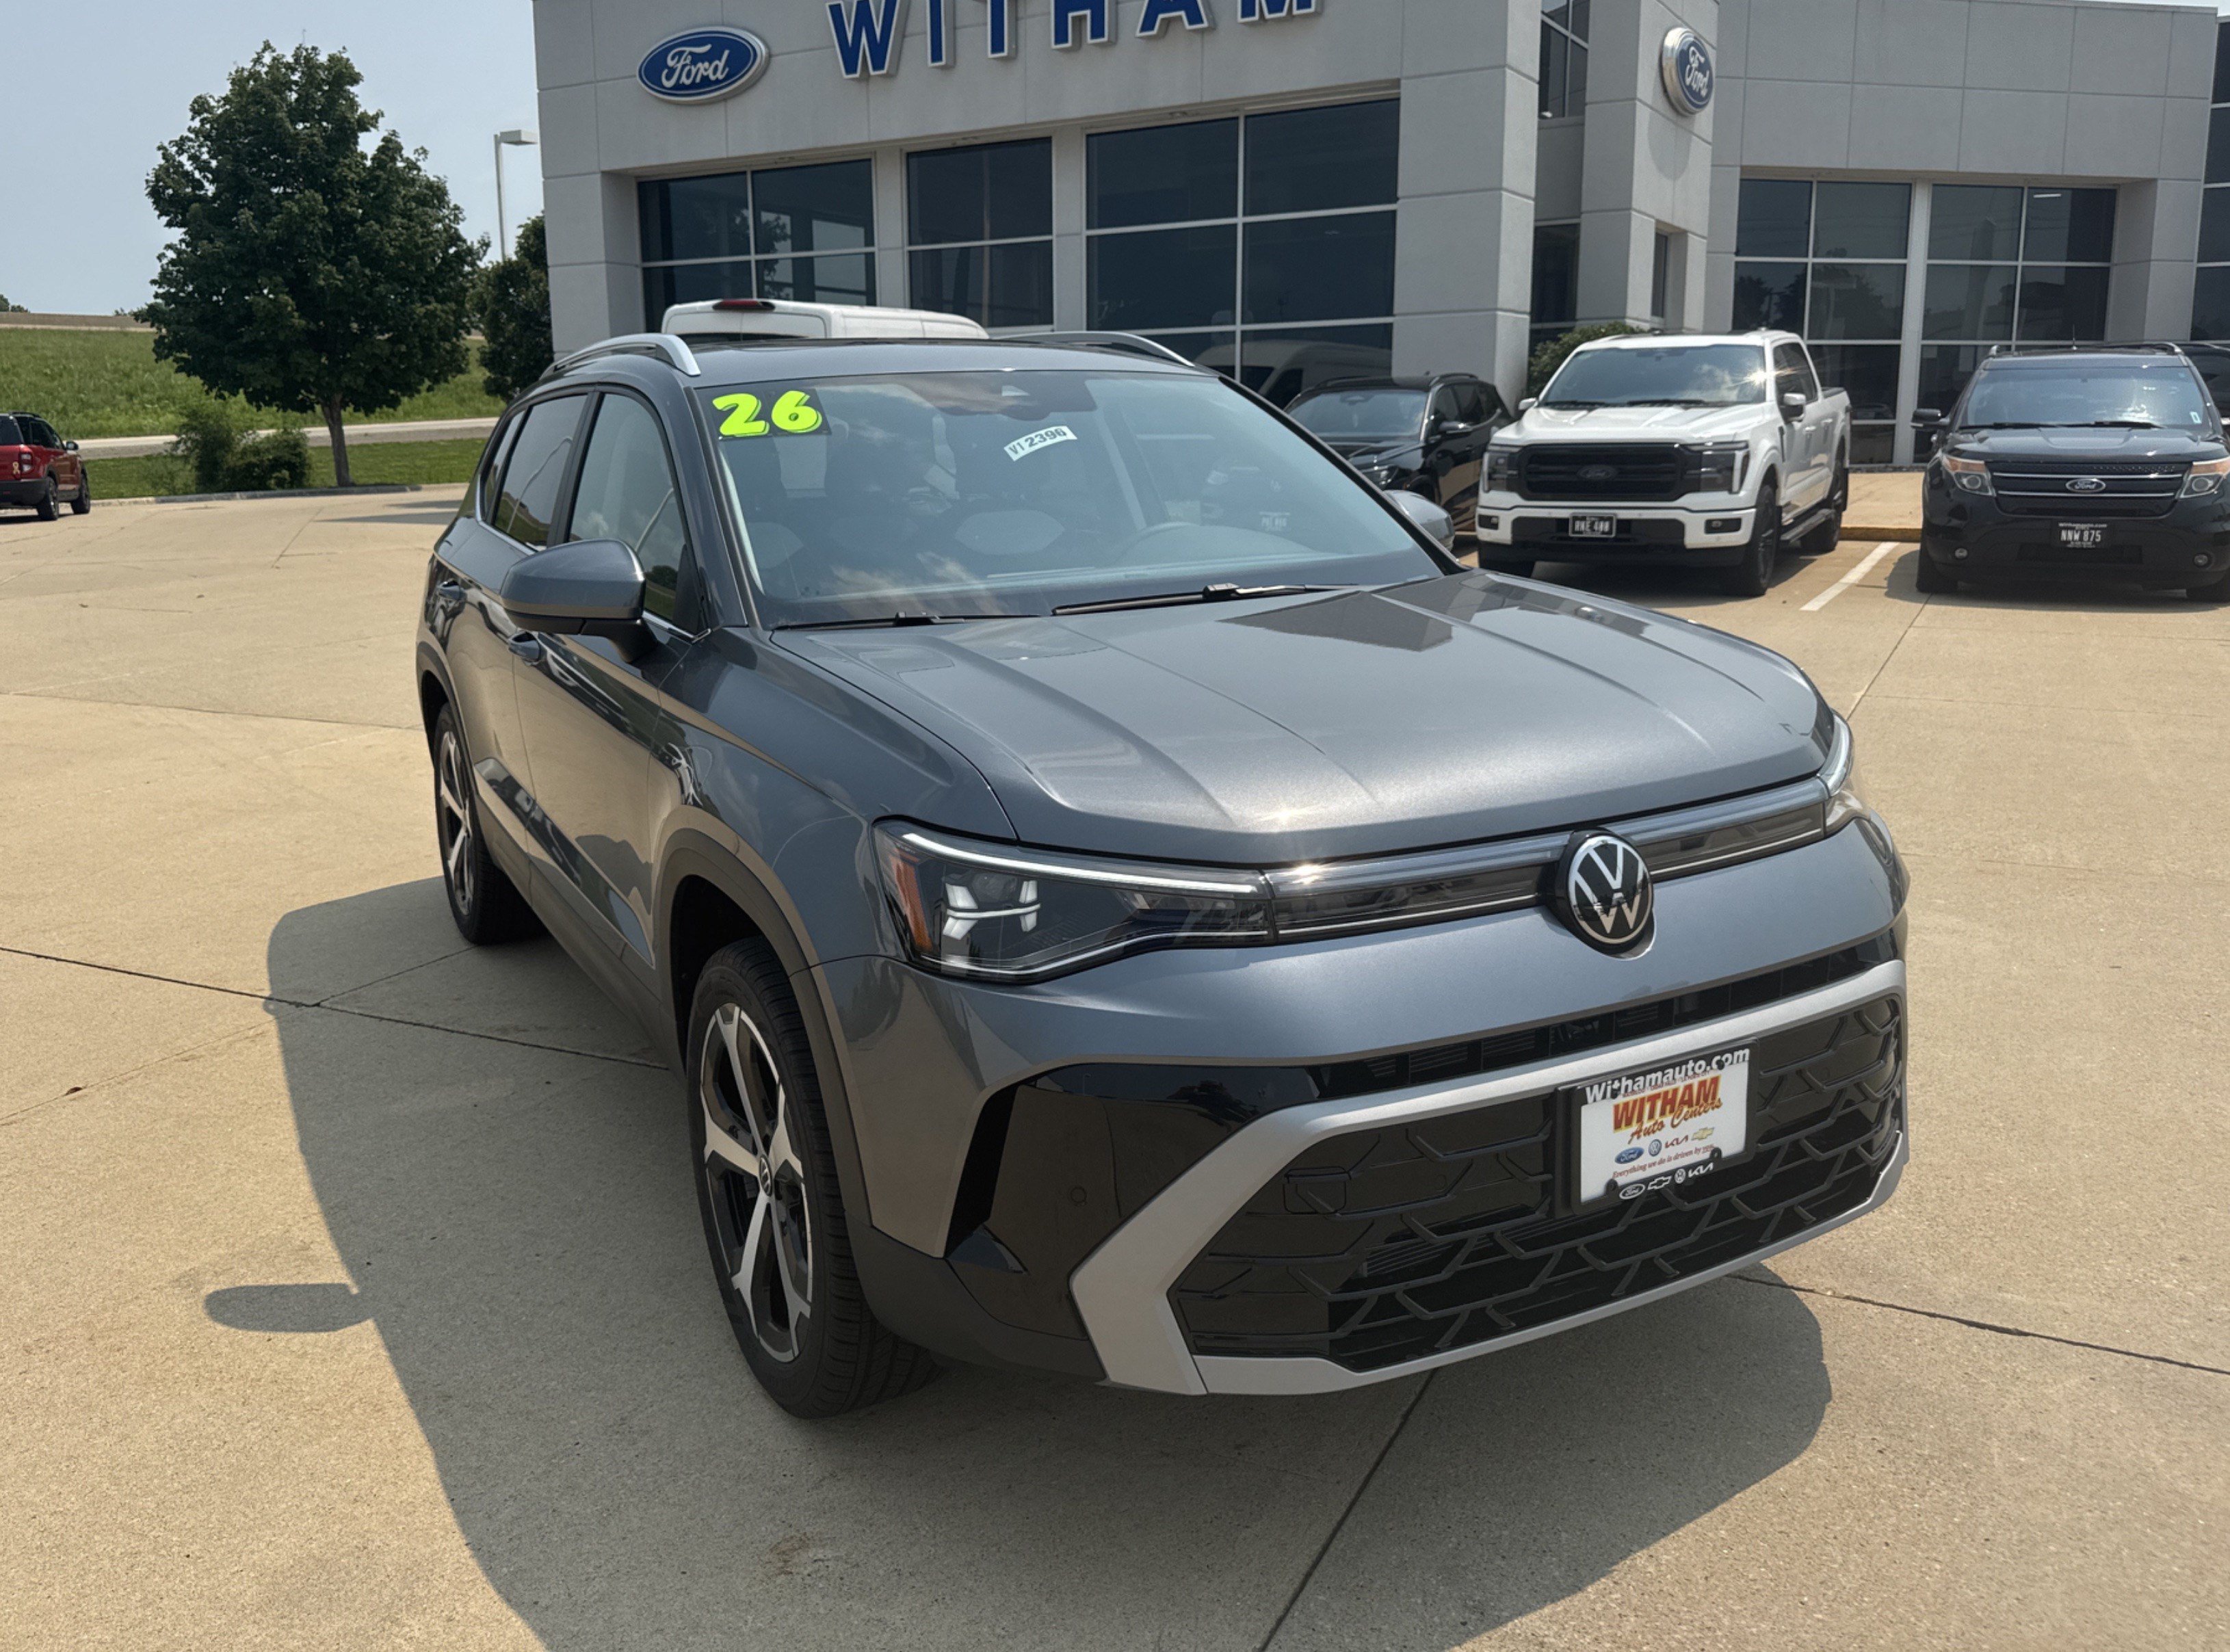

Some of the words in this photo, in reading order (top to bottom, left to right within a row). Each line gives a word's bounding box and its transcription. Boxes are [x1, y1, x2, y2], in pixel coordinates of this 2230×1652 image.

[661, 44, 730, 88] Ford
[1685, 46, 1710, 98] Ford
[712, 390, 823, 437] 26
[1586, 1048, 1750, 1104] Withamauto.com
[1612, 1075, 1722, 1133] WITHAM
[1627, 1120, 1665, 1144] Auto
[1670, 1097, 1723, 1128] Centers
[1612, 1164, 1647, 1179] Everything
